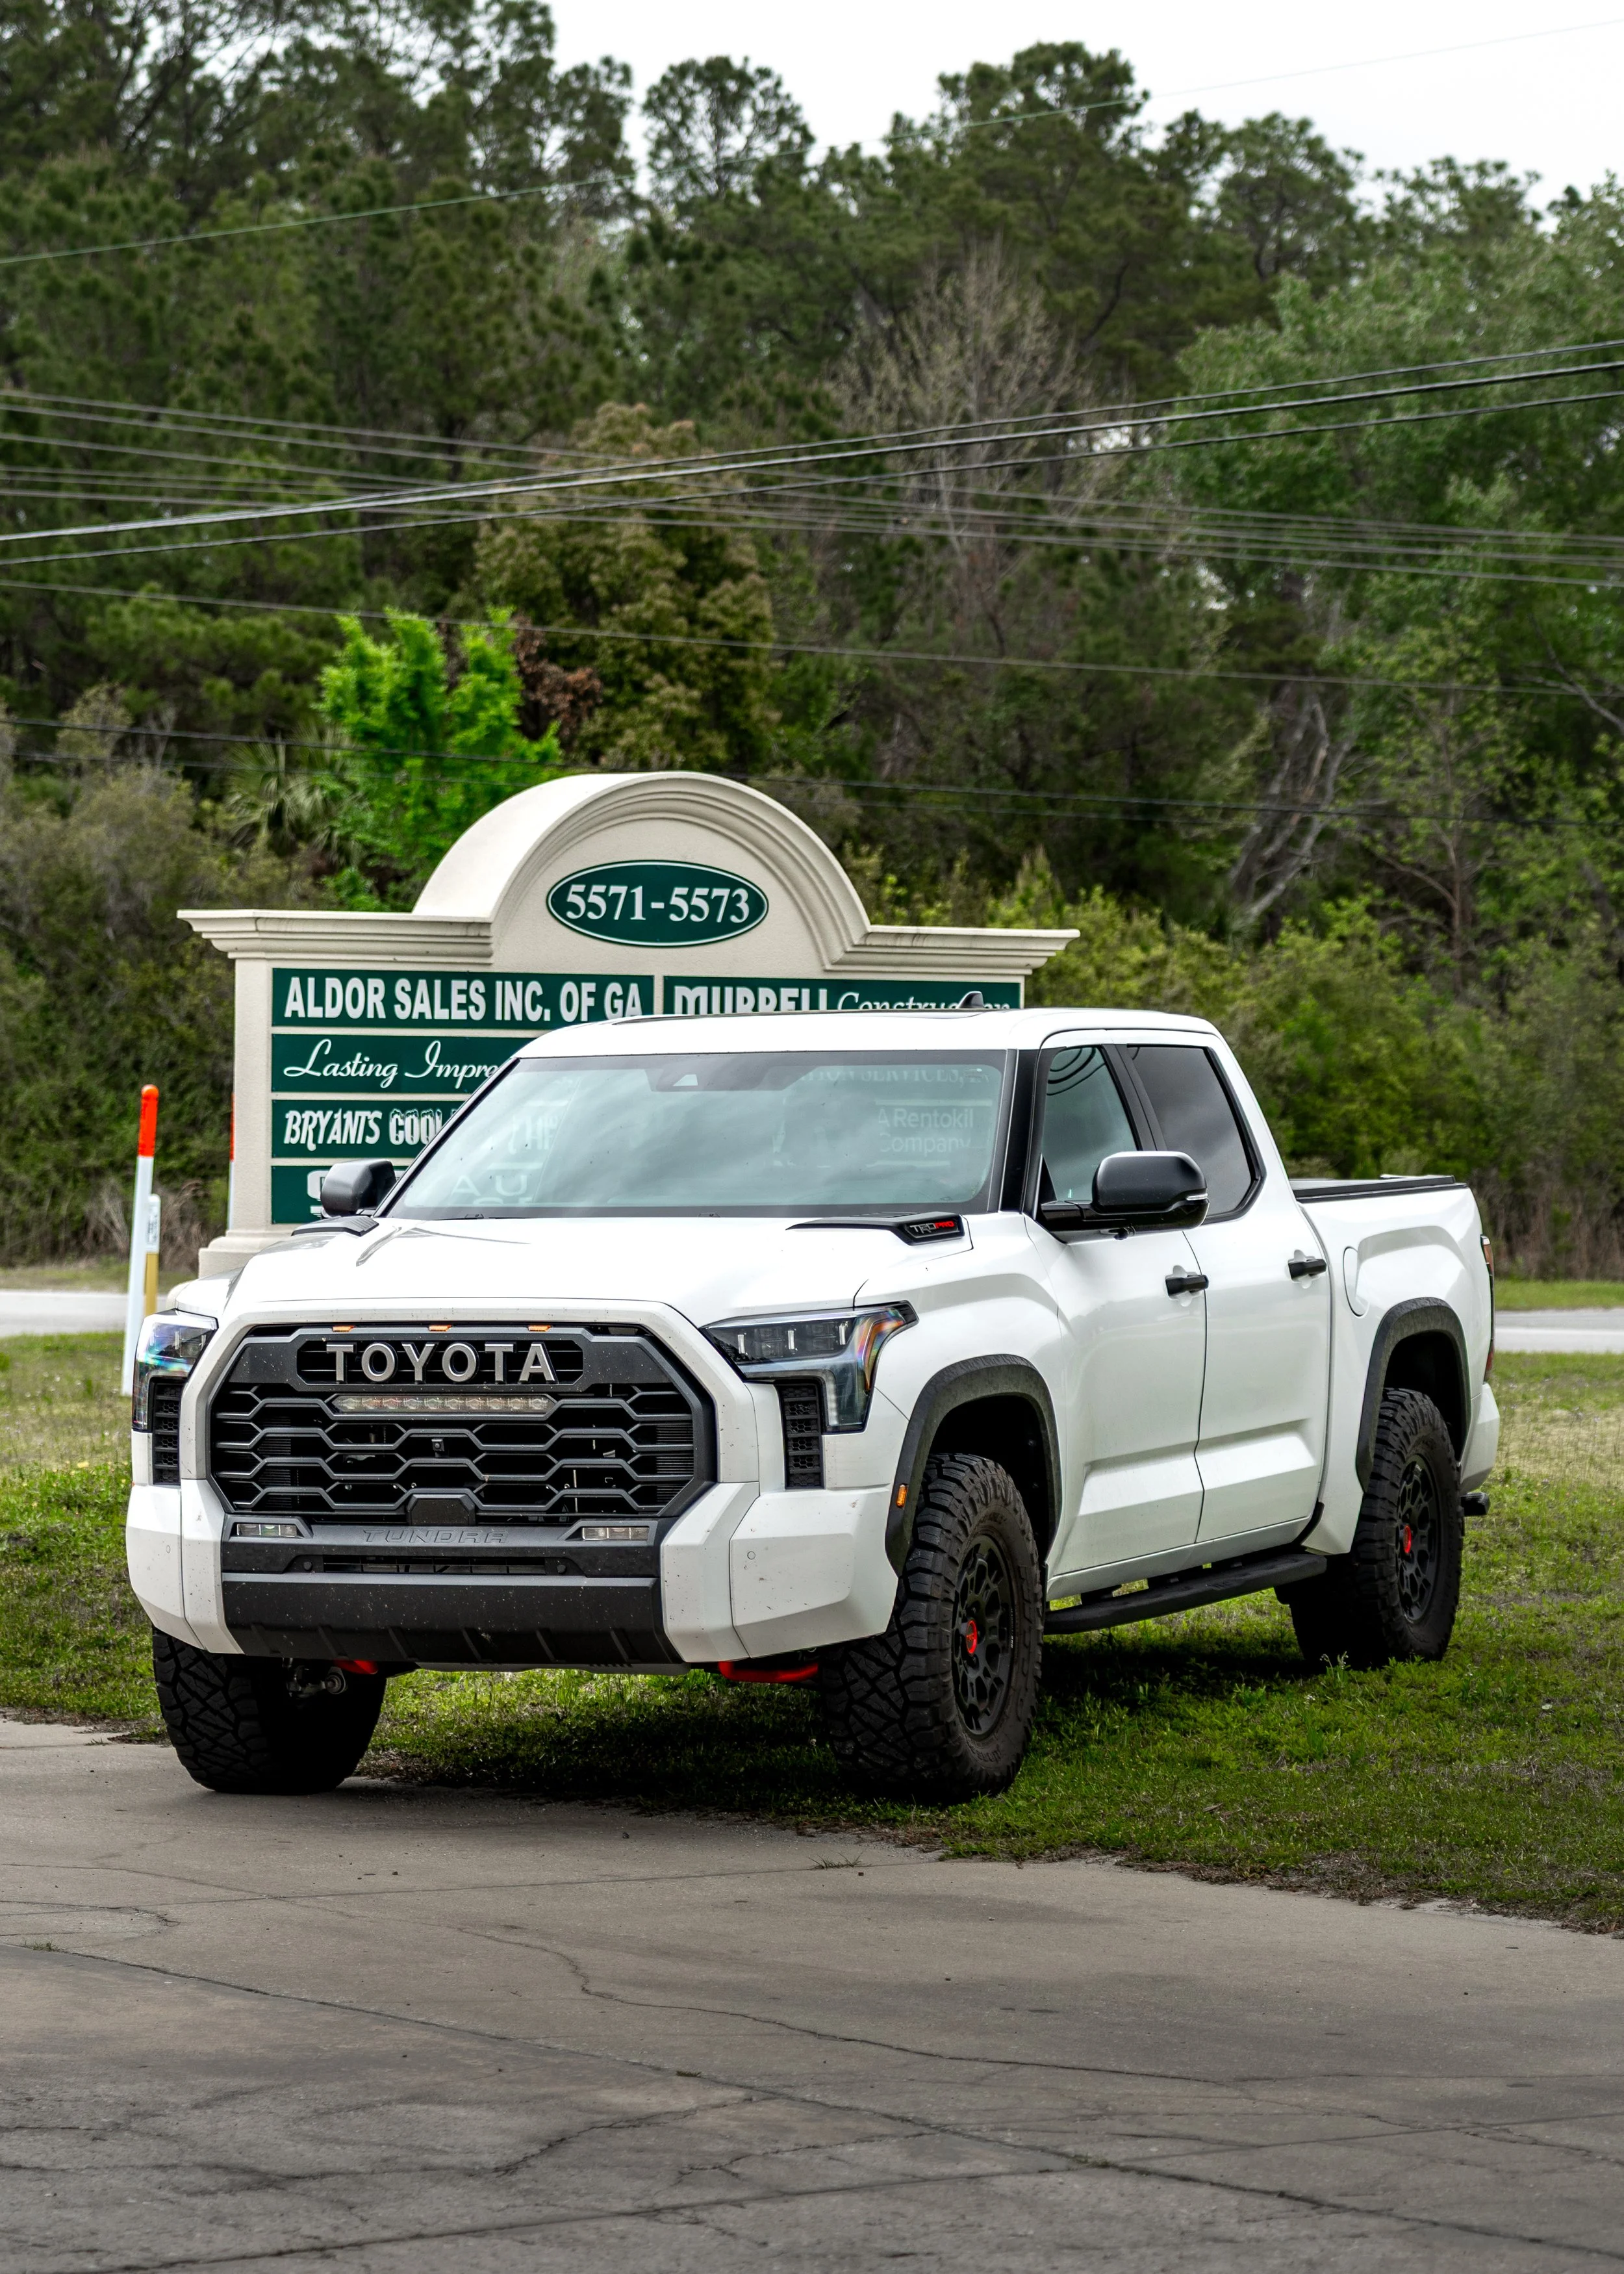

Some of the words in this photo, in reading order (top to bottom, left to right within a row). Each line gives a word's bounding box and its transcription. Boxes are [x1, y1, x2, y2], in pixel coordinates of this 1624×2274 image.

[566, 884, 750, 923] 5571-5573
[284, 977, 386, 1019] ALDOR
[394, 978, 486, 1021] SALES
[494, 980, 551, 1021] INC.
[559, 981, 596, 1023] OF
[604, 982, 643, 1020] GA
[283, 1038, 398, 1089] Lasting
[404, 1040, 498, 1090] Impre
[283, 1108, 383, 1151] BRYANTS
[893, 1108, 974, 1128] Rentokil
[326, 1342, 557, 1383] TOYOTA
[363, 1529, 509, 1543] TUNDRA
